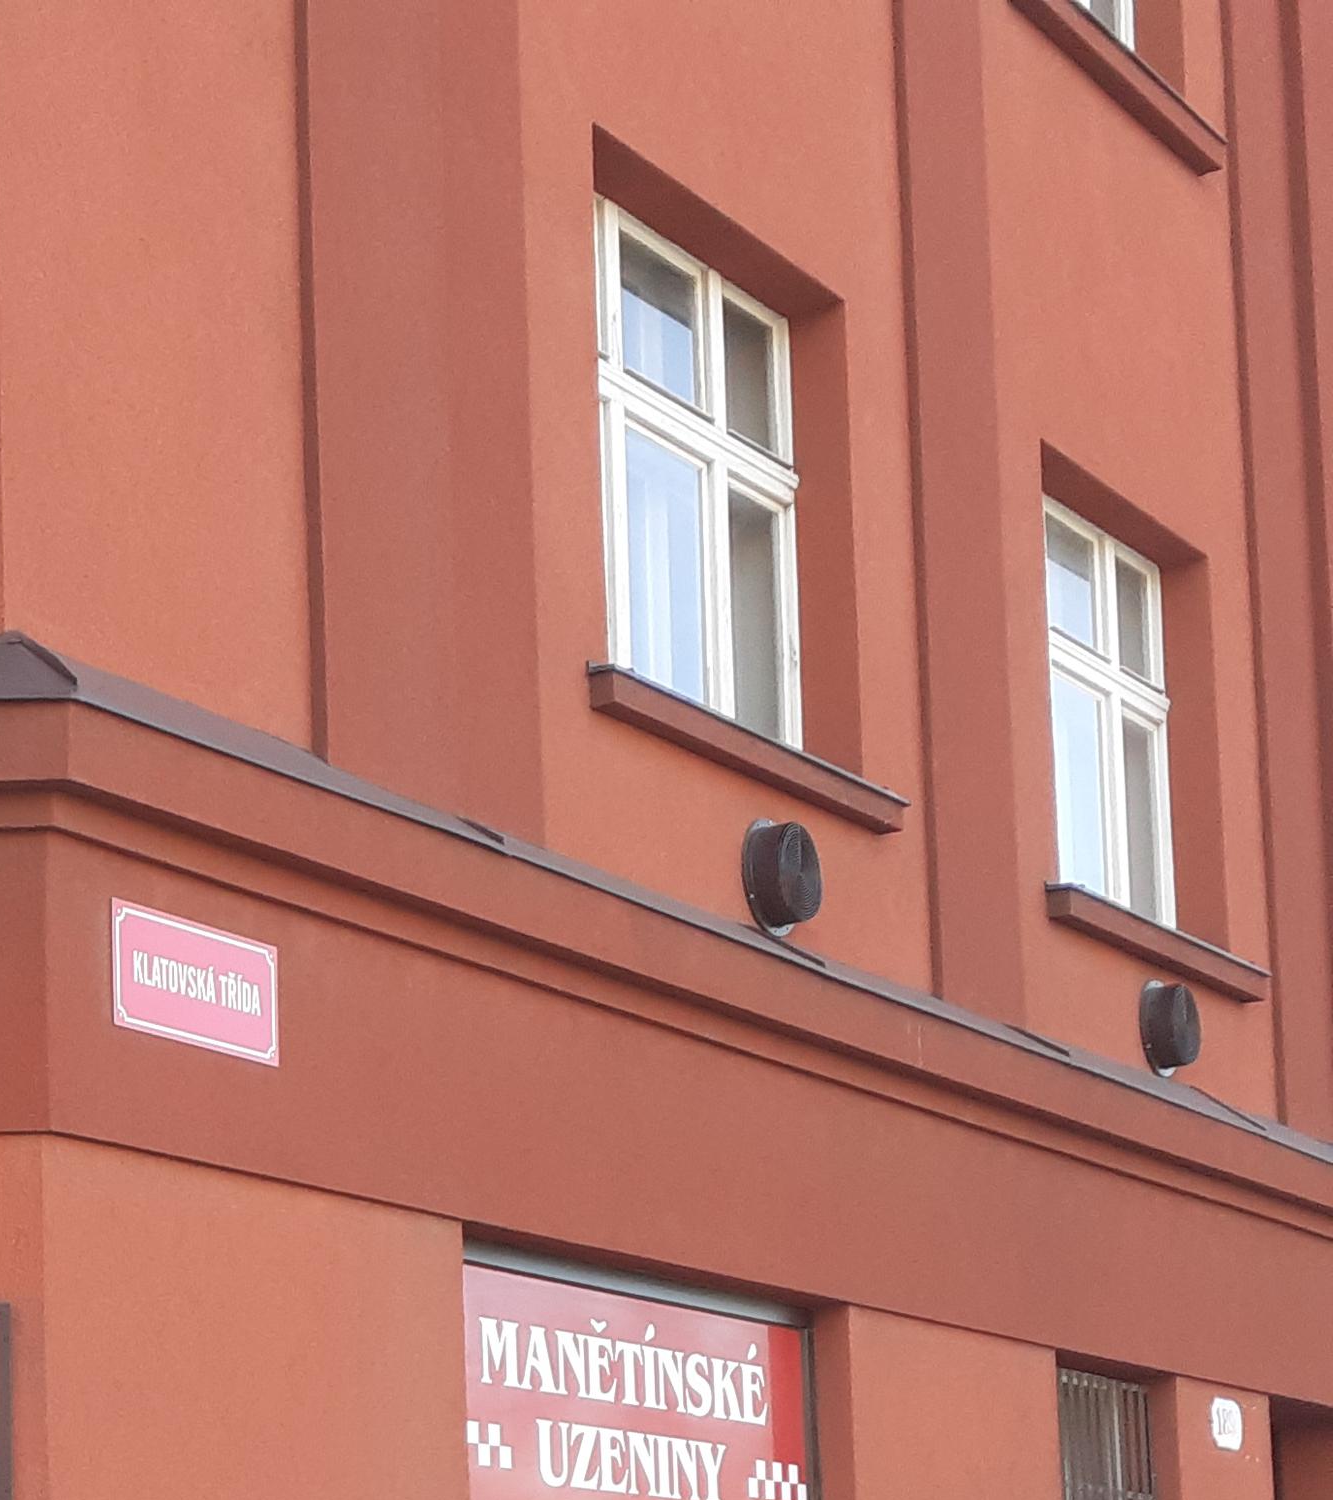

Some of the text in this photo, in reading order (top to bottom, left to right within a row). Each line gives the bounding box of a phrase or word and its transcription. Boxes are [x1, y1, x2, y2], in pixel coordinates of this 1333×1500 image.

[133, 950, 262, 1017] KLATOVSKÁ TŘÍDA
[478, 1316, 769, 1426] MANĚTÍNSKÉ
